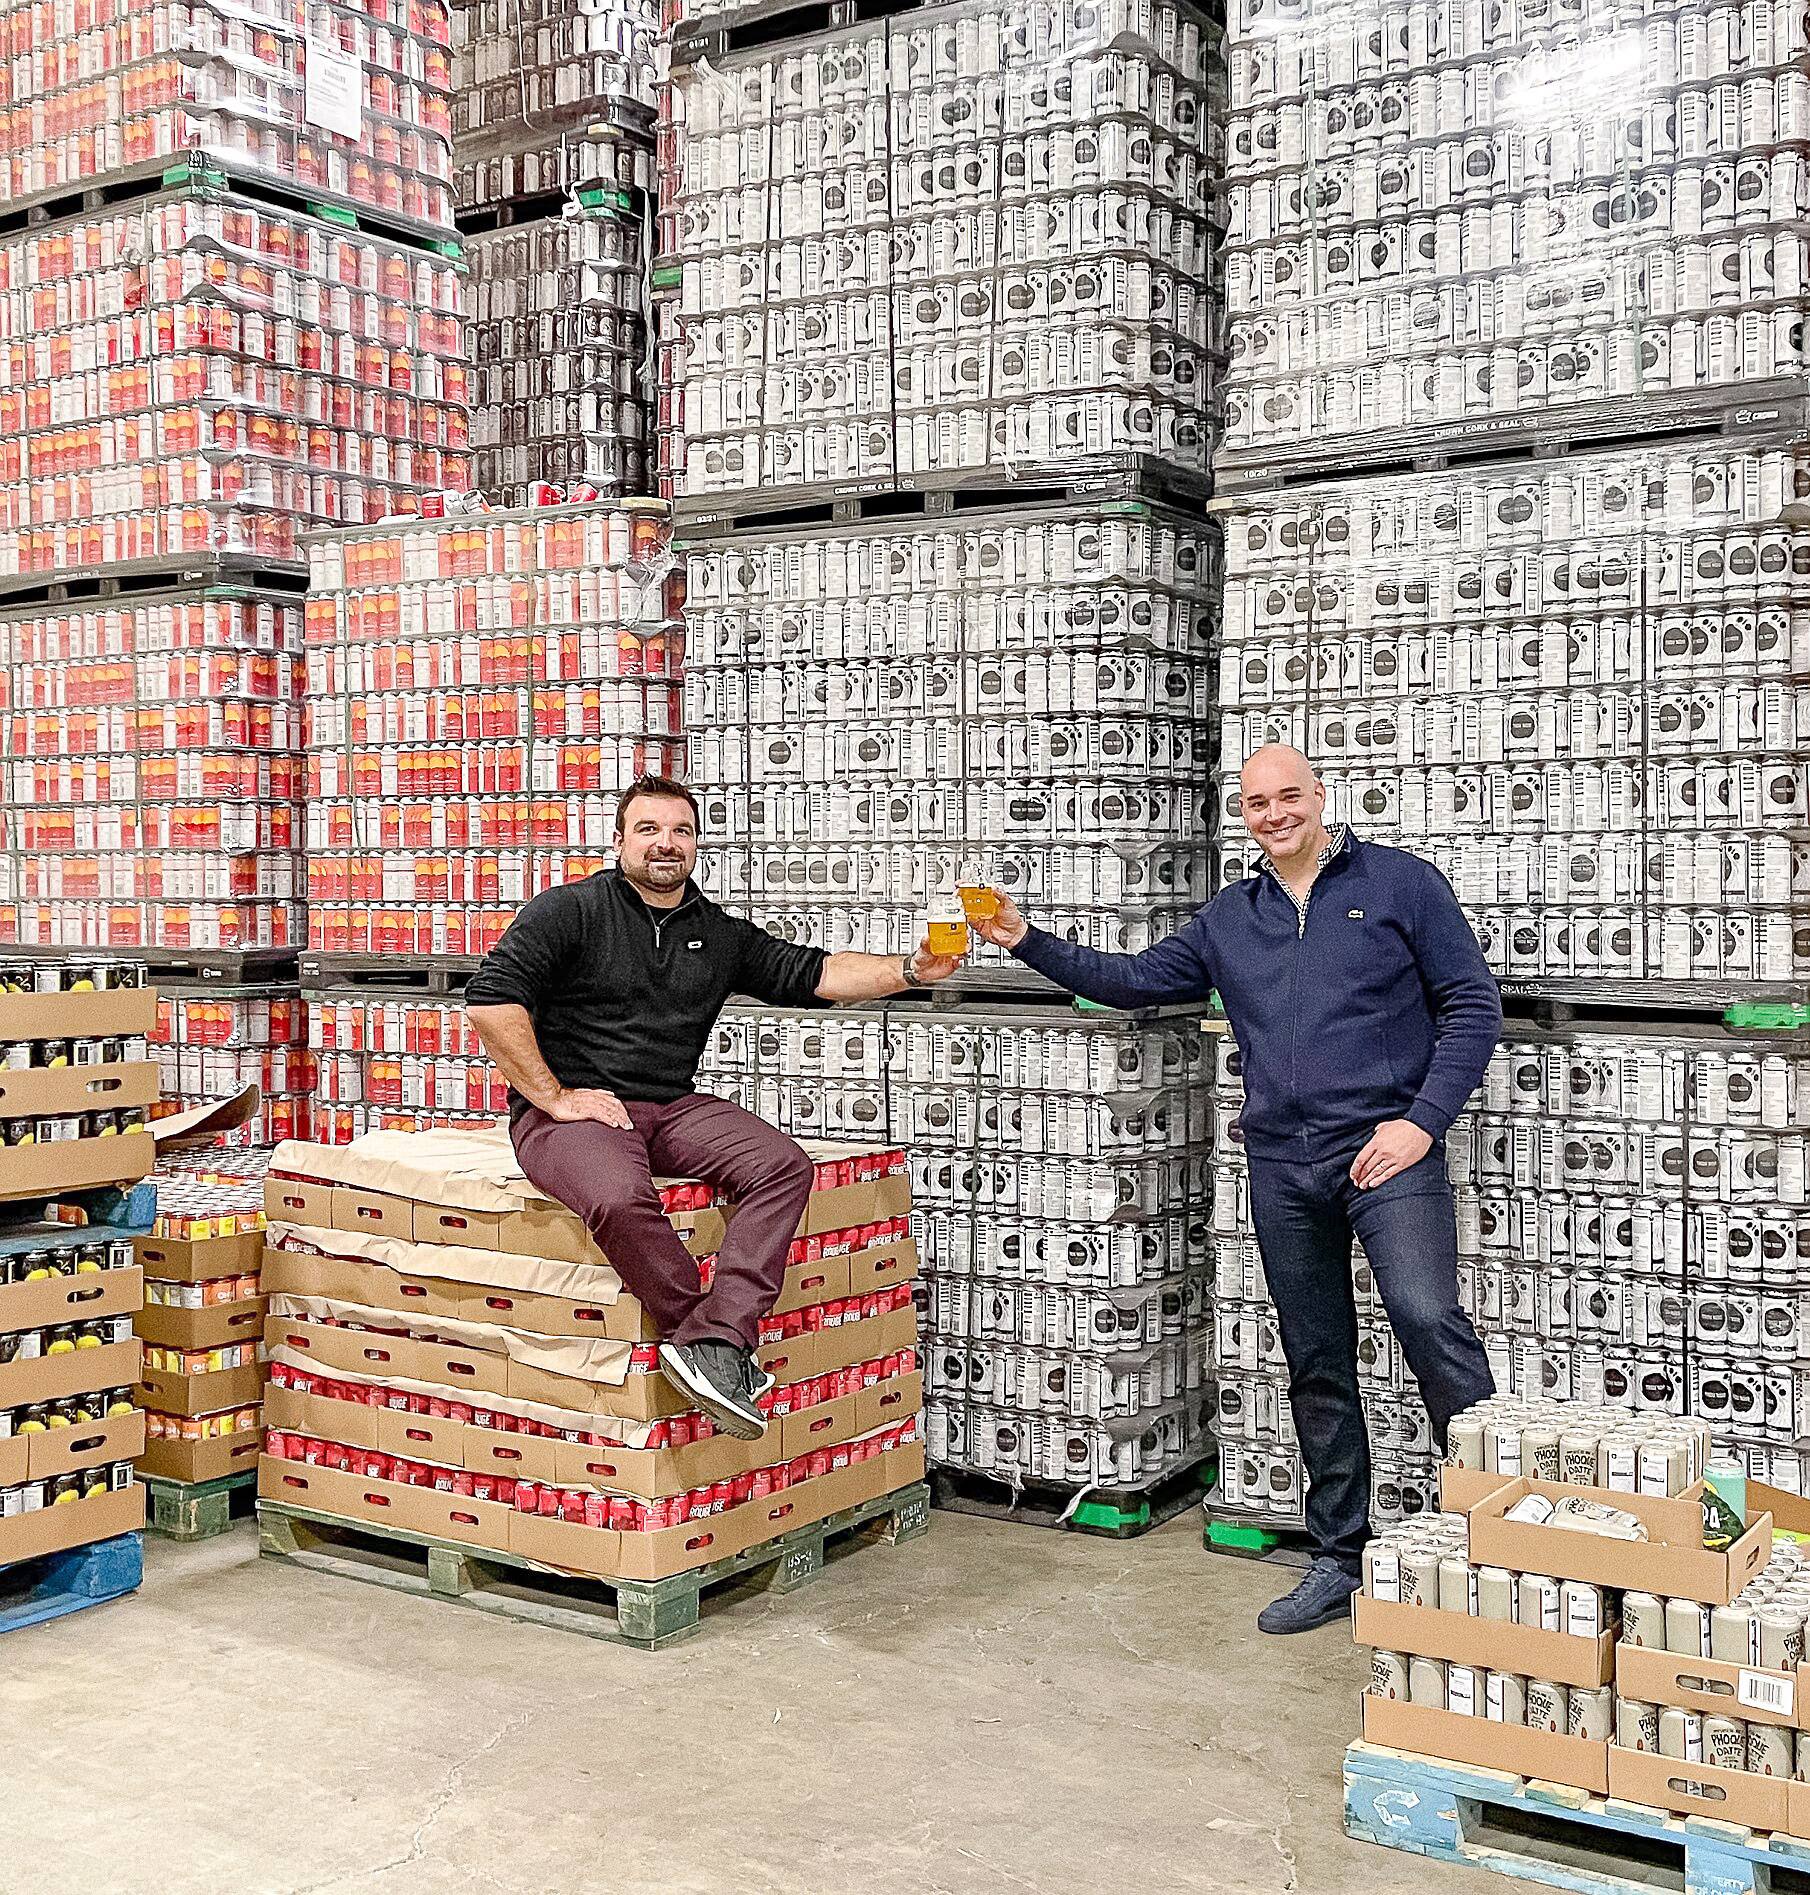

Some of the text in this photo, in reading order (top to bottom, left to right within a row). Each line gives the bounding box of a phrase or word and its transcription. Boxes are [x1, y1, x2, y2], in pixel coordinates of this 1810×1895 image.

[1434, 419, 1521, 438] CROWN CORK & SEAL
[835, 486, 858, 494] CROWN
[1564, 1454, 1596, 1468] PHOQUE
[1711, 1734, 1745, 1750] PHOQUE
[1717, 1746, 1743, 1757] DATTE
